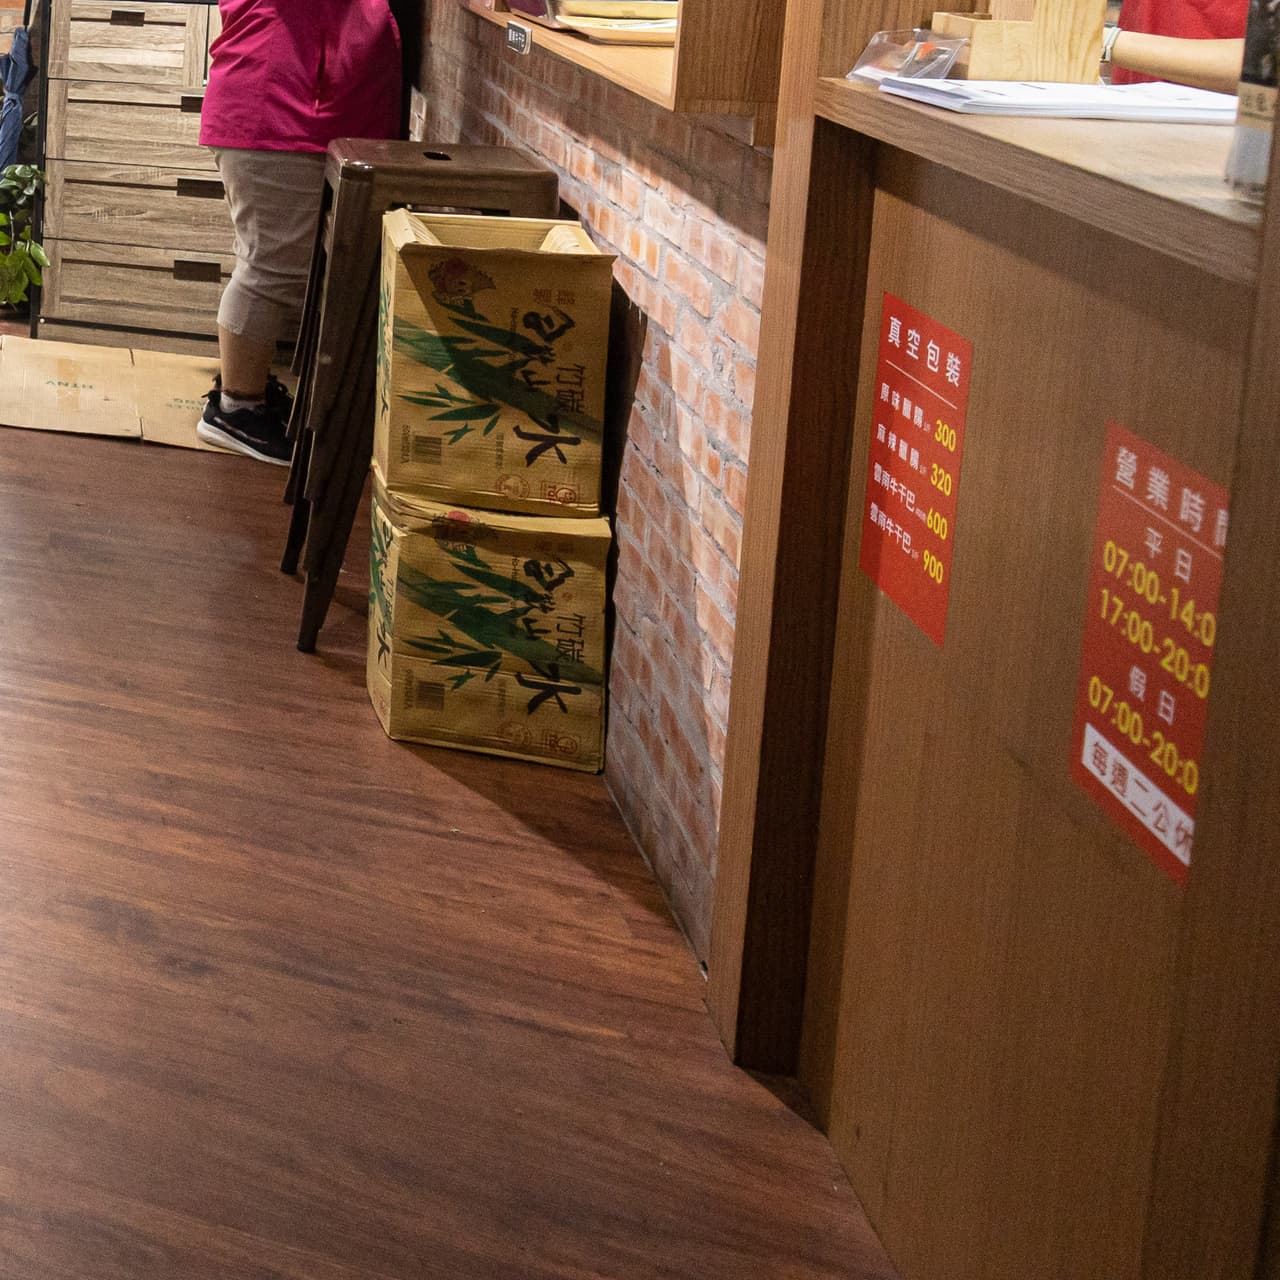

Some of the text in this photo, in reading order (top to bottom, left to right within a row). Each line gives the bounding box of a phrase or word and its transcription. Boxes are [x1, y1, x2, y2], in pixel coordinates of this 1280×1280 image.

[887, 315, 962, 388] 真空包裝
[934, 418, 956, 453] 300
[873, 462, 948, 541] 雲南牛干巴 600
[930, 463, 952, 497] 320
[869, 501, 912, 554] 雲南牛干巴
[923, 549, 944, 585] 900
[1143, 526, 1193, 584] 平日
[1128, 664, 1177, 725] 假日
